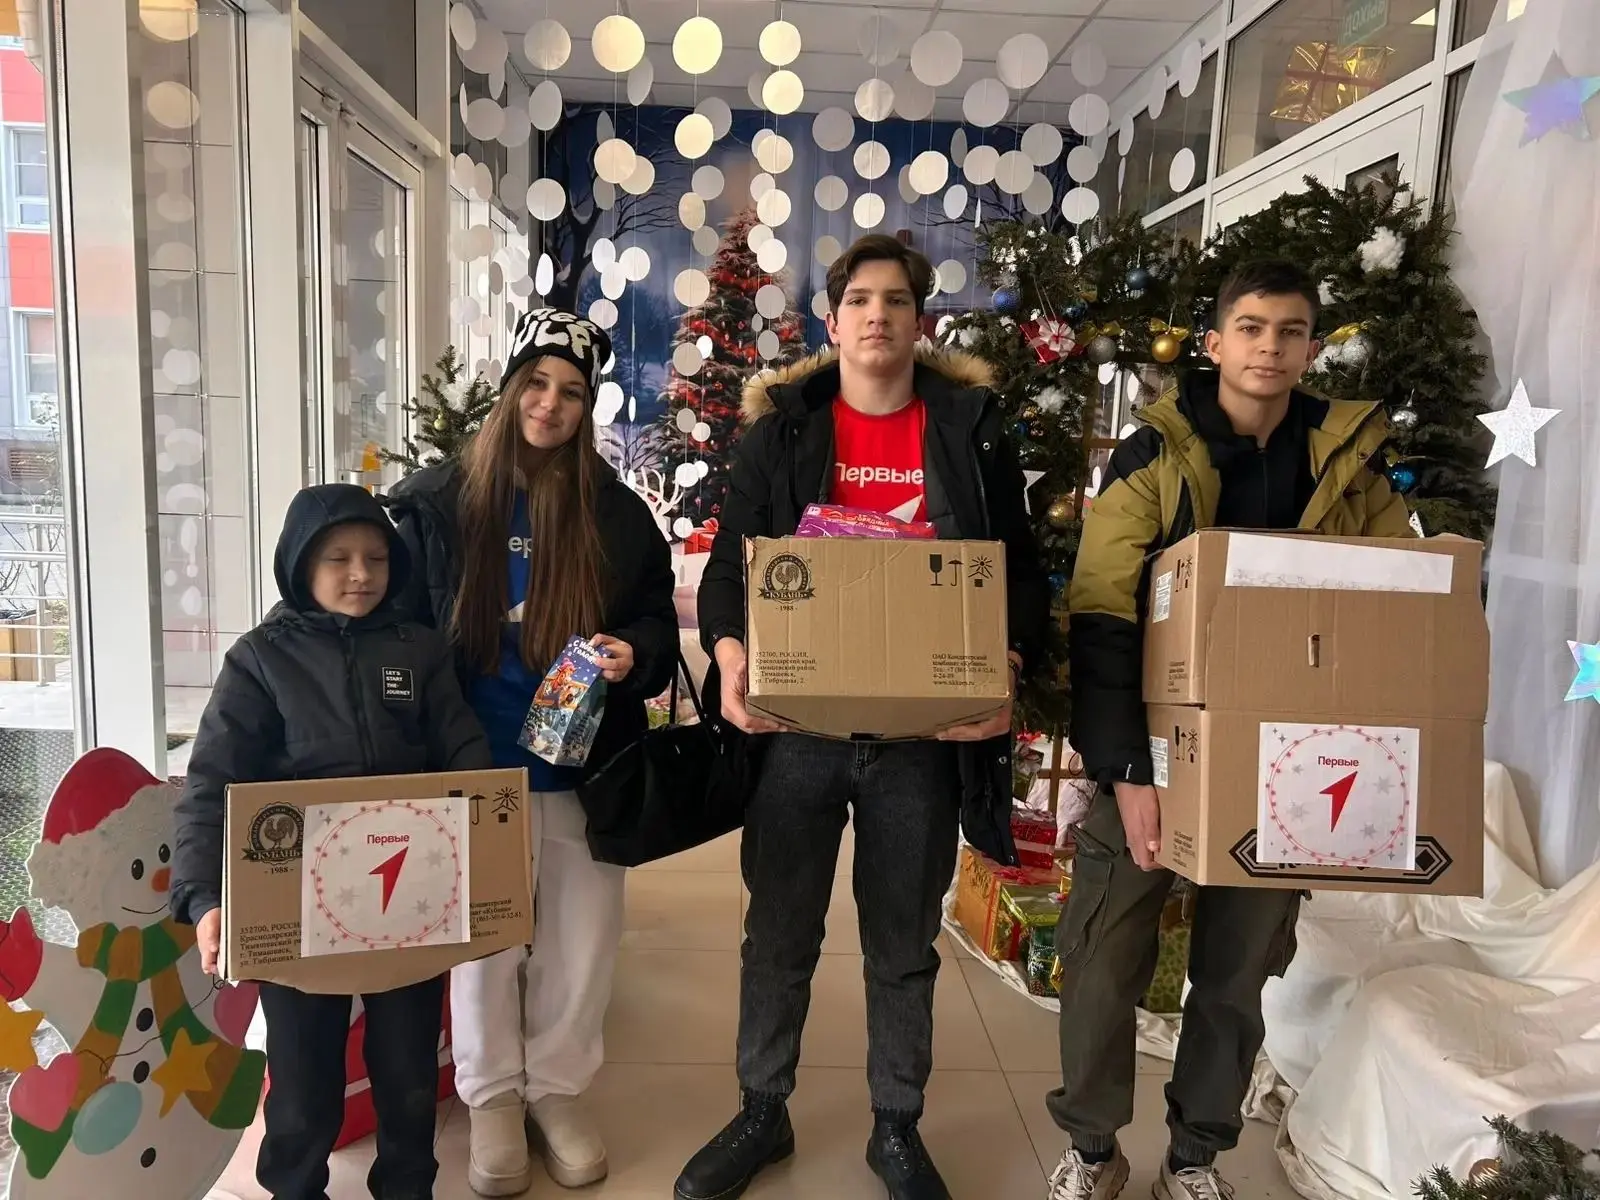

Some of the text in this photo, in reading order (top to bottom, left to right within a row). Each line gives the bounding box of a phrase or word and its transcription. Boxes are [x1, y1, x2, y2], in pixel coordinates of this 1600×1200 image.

[1318, 756, 1359, 768] Первые
[367, 834, 410, 846] Первые
[271, 921, 301, 931] РОССИ
